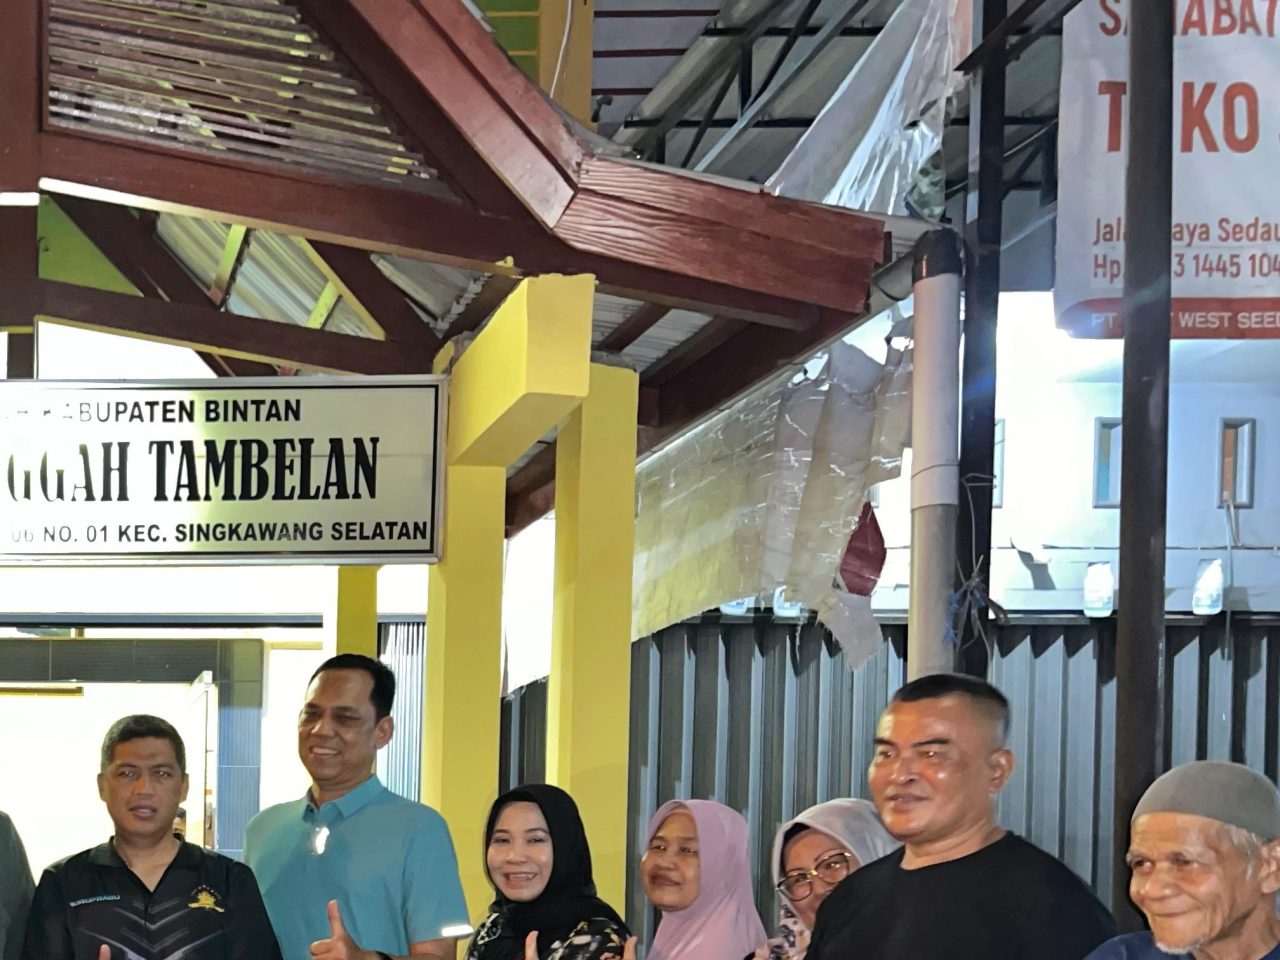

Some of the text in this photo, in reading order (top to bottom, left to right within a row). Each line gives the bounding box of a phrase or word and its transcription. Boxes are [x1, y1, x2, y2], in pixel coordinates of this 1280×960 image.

[1099, 0, 1279, 37] SABAT
[1098, 81, 1260, 153] TKO
[1172, 222, 1210, 248] aya
[1192, 253, 1241, 278] 1445
[1179, 312, 1233, 328] WEST
[205, 399, 301, 422] BINTAN
[148, 436, 380, 503] TAMBELAN
[43, 525, 78, 543] NO.
[86, 525, 109, 542] 01
[118, 524, 168, 543] KEC.
[175, 522, 324, 543] SINGKAWANG
[331, 521, 428, 541] SELATAN
